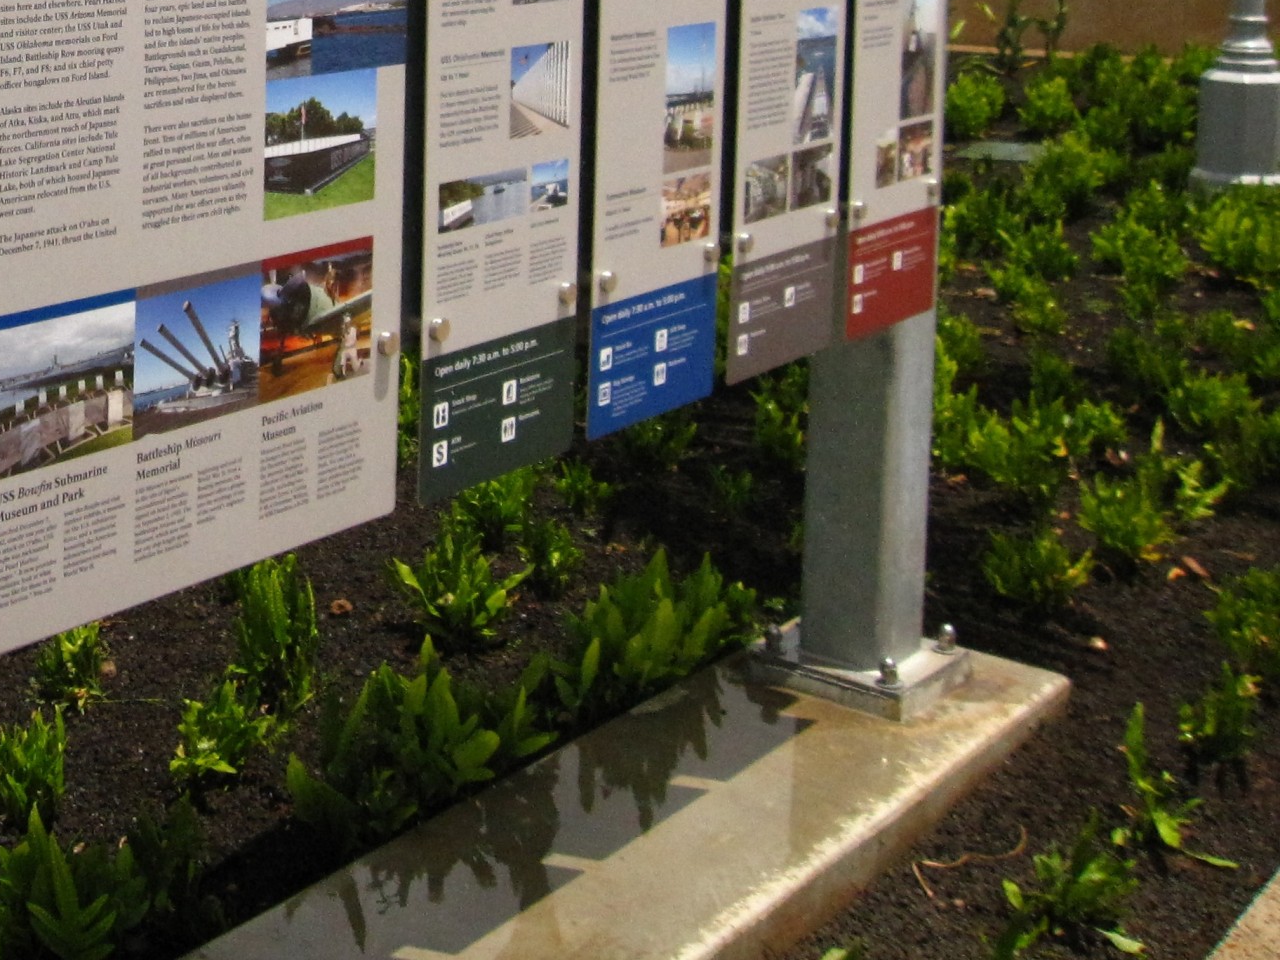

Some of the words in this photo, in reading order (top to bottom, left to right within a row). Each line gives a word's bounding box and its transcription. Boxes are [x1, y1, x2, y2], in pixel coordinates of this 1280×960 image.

[261, 410, 289, 426] Pacific
[291, 402, 323, 417] Aviation
[261, 426, 296, 441] Museum
[136, 443, 183, 464] Battleship
[184, 432, 221, 448] Missouri
[136, 458, 180, 480] Memorial
[17, 480, 52, 499] Bowfin
[53, 466, 107, 488] Submarine
[40, 494, 59, 510] and
[61, 487, 84, 503] Park
